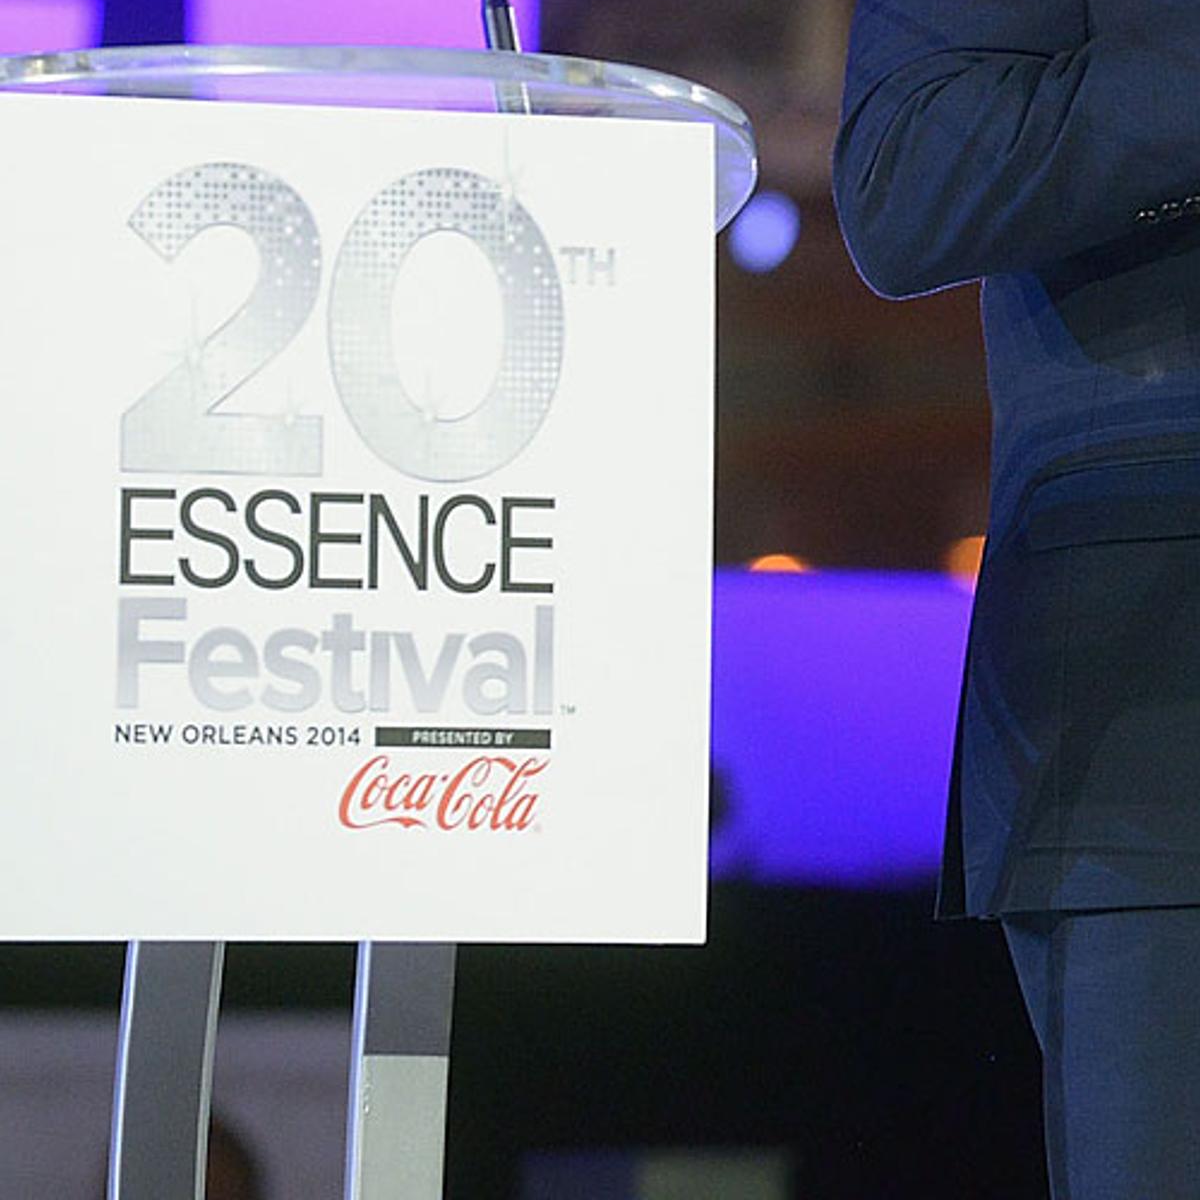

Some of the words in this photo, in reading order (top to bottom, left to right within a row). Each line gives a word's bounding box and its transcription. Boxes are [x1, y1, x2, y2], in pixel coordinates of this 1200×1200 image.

[119, 488, 556, 594] ESSENCE
[116, 597, 555, 716] Festival
[115, 724, 173, 743] NEW
[182, 725, 297, 745] ORLEANS
[307, 726, 361, 746] 2014
[412, 731, 491, 745] PRESENTED
[494, 732, 514, 745] BY
[338, 754, 550, 831] Coca-Cola
